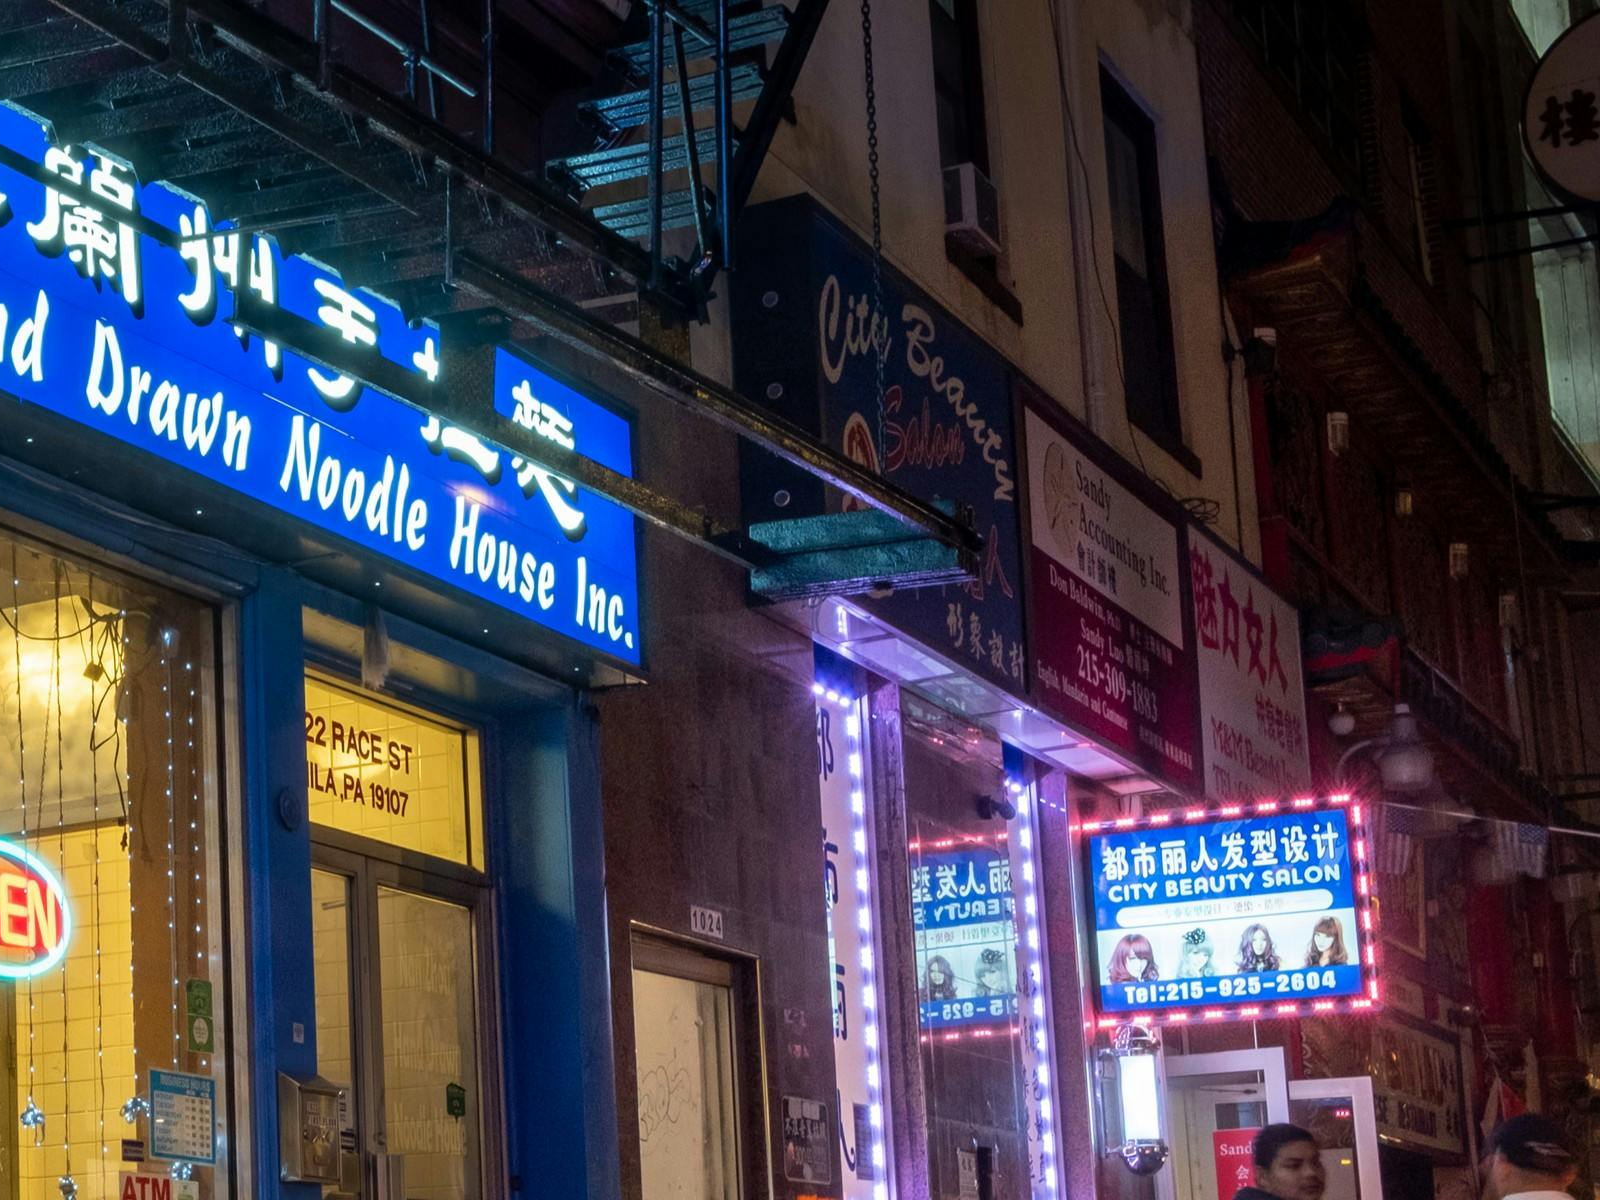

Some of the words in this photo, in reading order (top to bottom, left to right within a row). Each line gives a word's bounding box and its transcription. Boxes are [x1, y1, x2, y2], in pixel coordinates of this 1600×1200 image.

[819, 274, 892, 385] City
[901, 303, 1015, 500] Beauty
[883, 385, 965, 472] Salon
[86, 319, 251, 470] Drawn
[280, 415, 428, 550] Noodle
[450, 484, 554, 609] House
[576, 556, 633, 648] Inc.
[1076, 460, 1111, 521] Sandy
[1079, 502, 1147, 588] Accounting
[1150, 557, 1171, 596] Inc.
[1050, 564, 1068, 595] Don
[1080, 617, 1105, 656] Sandy
[1077, 643, 1158, 723] 215-309-1883
[332, 720, 383, 764] RACE
[388, 741, 412, 776] ST
[306, 760, 338, 797] ILA
[369, 782, 409, 818] 19107
[1102, 821, 1339, 881] 都市丽人发型设计
[1108, 881, 1158, 904] CITY
[1165, 872, 1254, 898] BEAUTY
[1261, 863, 1341, 889] SALON
[692, 908, 723, 938] 1024
[1219, 1140, 1256, 1157] Sand
[121, 1174, 172, 1200] ATM
